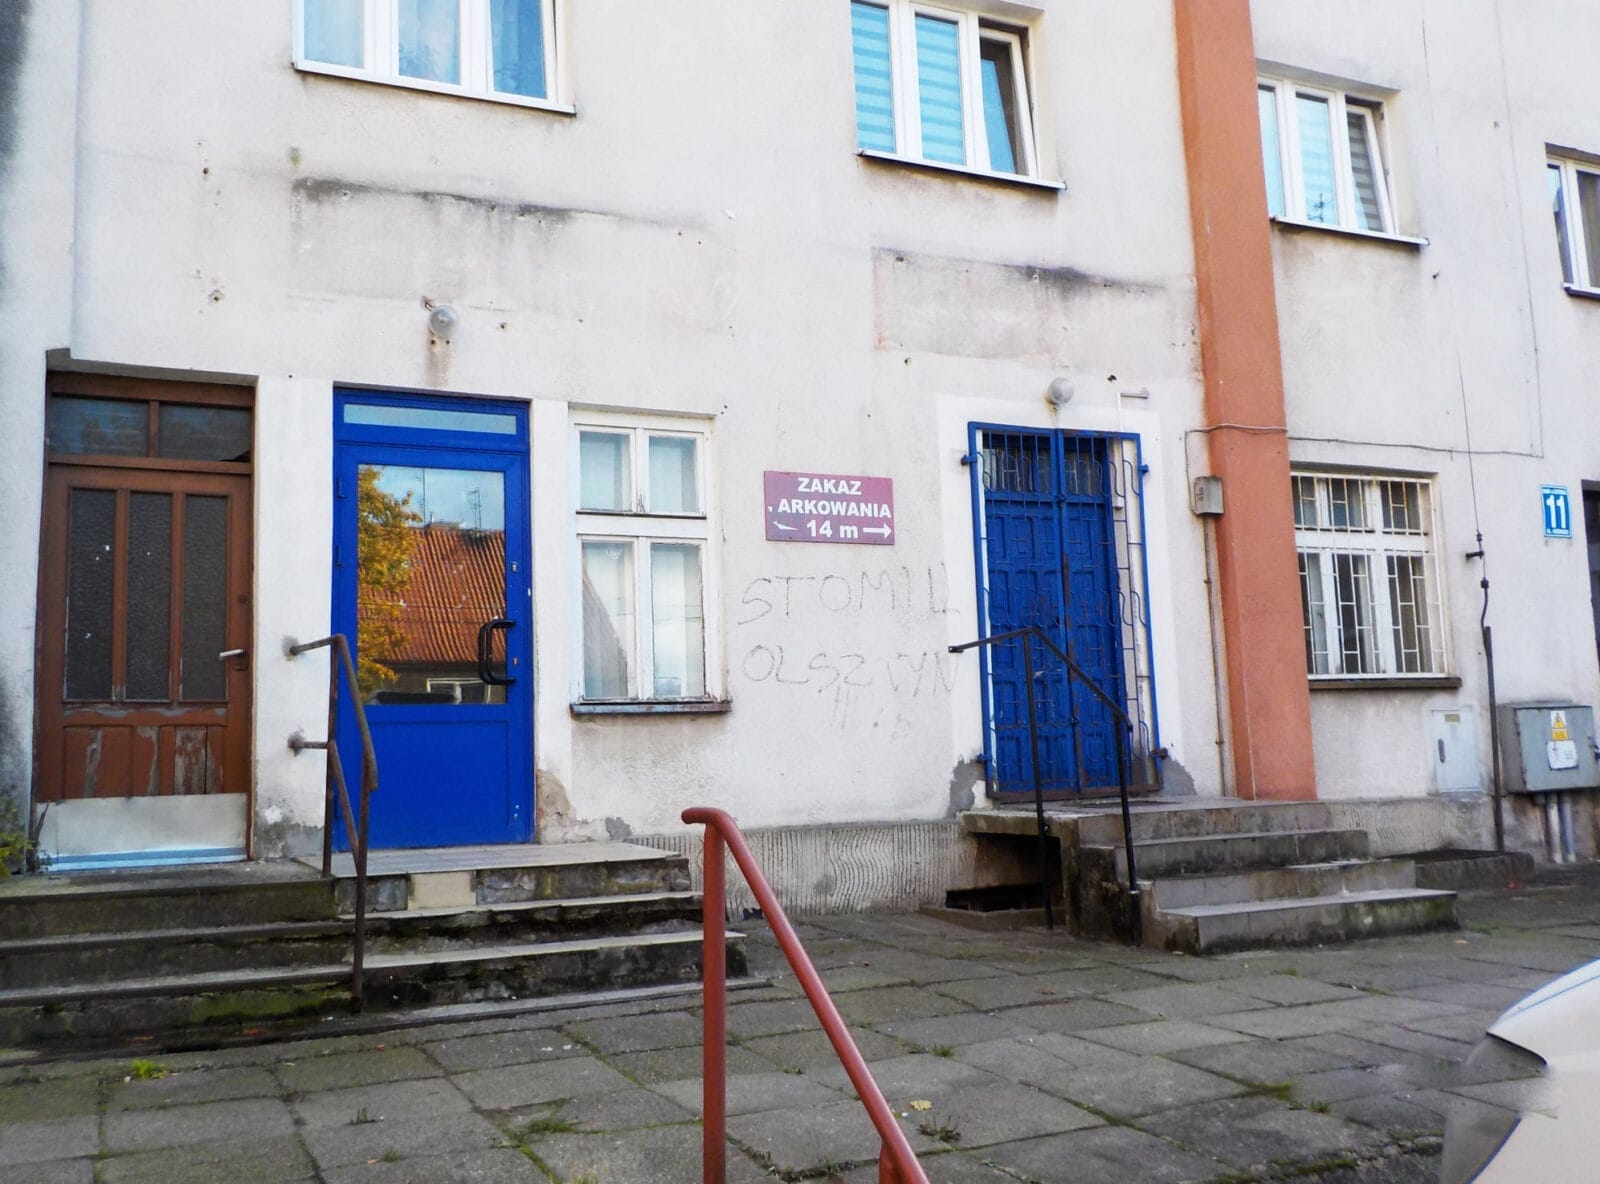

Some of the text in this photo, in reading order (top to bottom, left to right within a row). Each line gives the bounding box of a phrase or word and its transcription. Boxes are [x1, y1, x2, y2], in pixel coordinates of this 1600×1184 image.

[797, 477, 862, 496] ZAKAZ
[768, 498, 892, 518] ARKOWANIA
[1546, 494, 1567, 529] 11
[806, 520, 859, 538] 14 m
